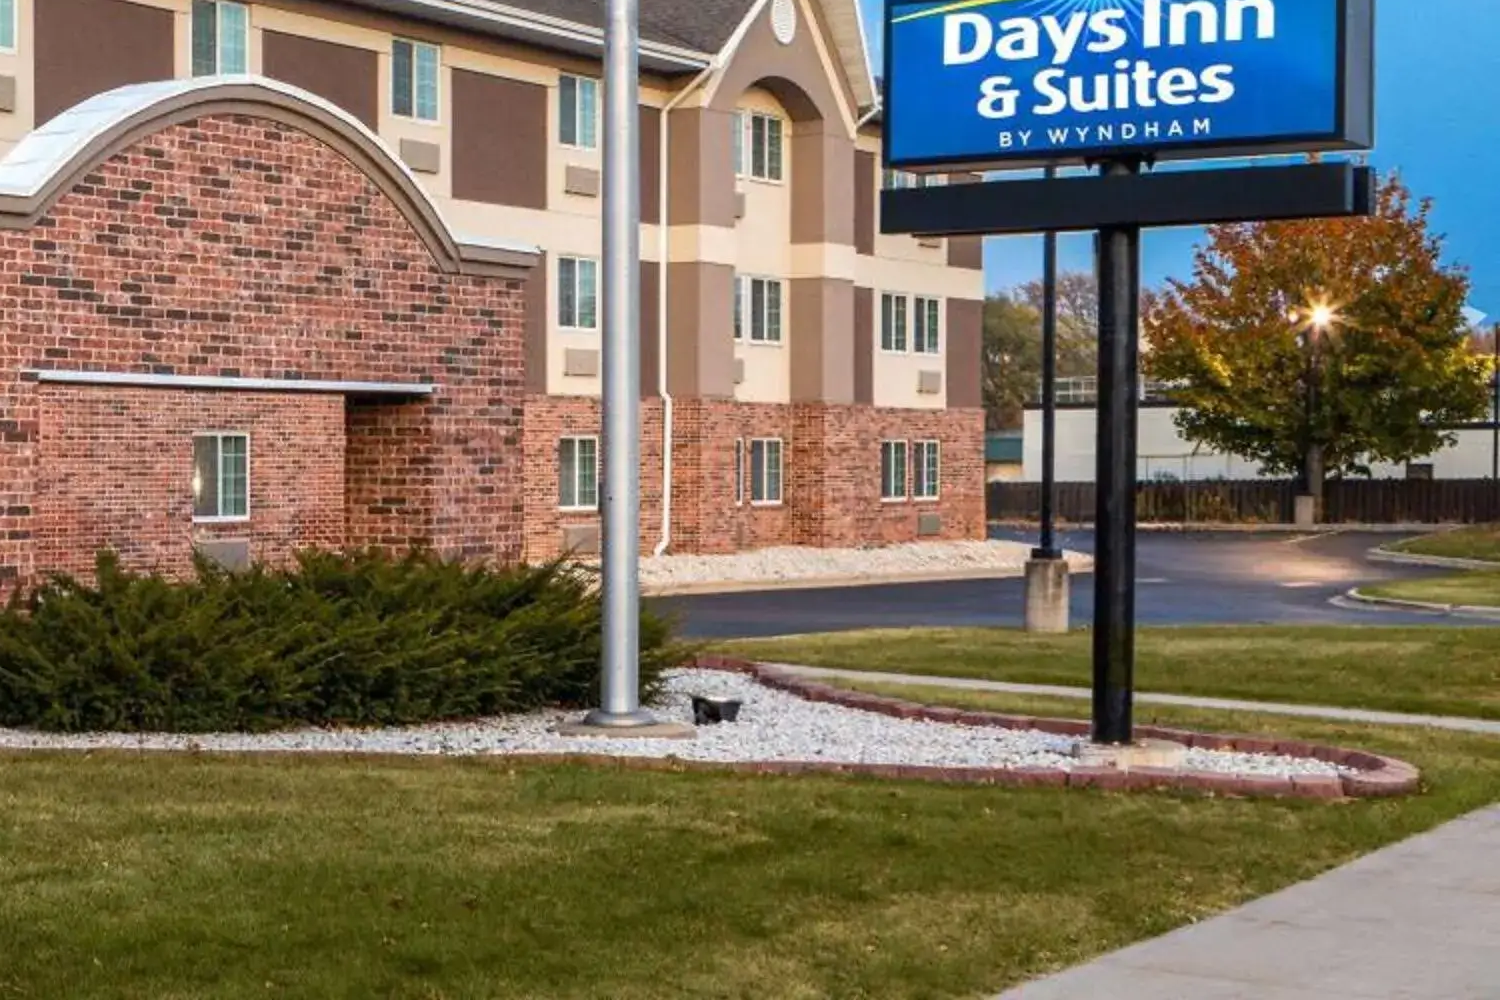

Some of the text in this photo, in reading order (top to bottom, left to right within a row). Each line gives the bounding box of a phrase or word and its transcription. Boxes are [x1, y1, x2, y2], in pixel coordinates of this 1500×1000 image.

[943, 7, 1127, 65] Days
[977, 59, 1235, 119] & Suites
[999, 118, 1211, 148] BY WYNDHAM
